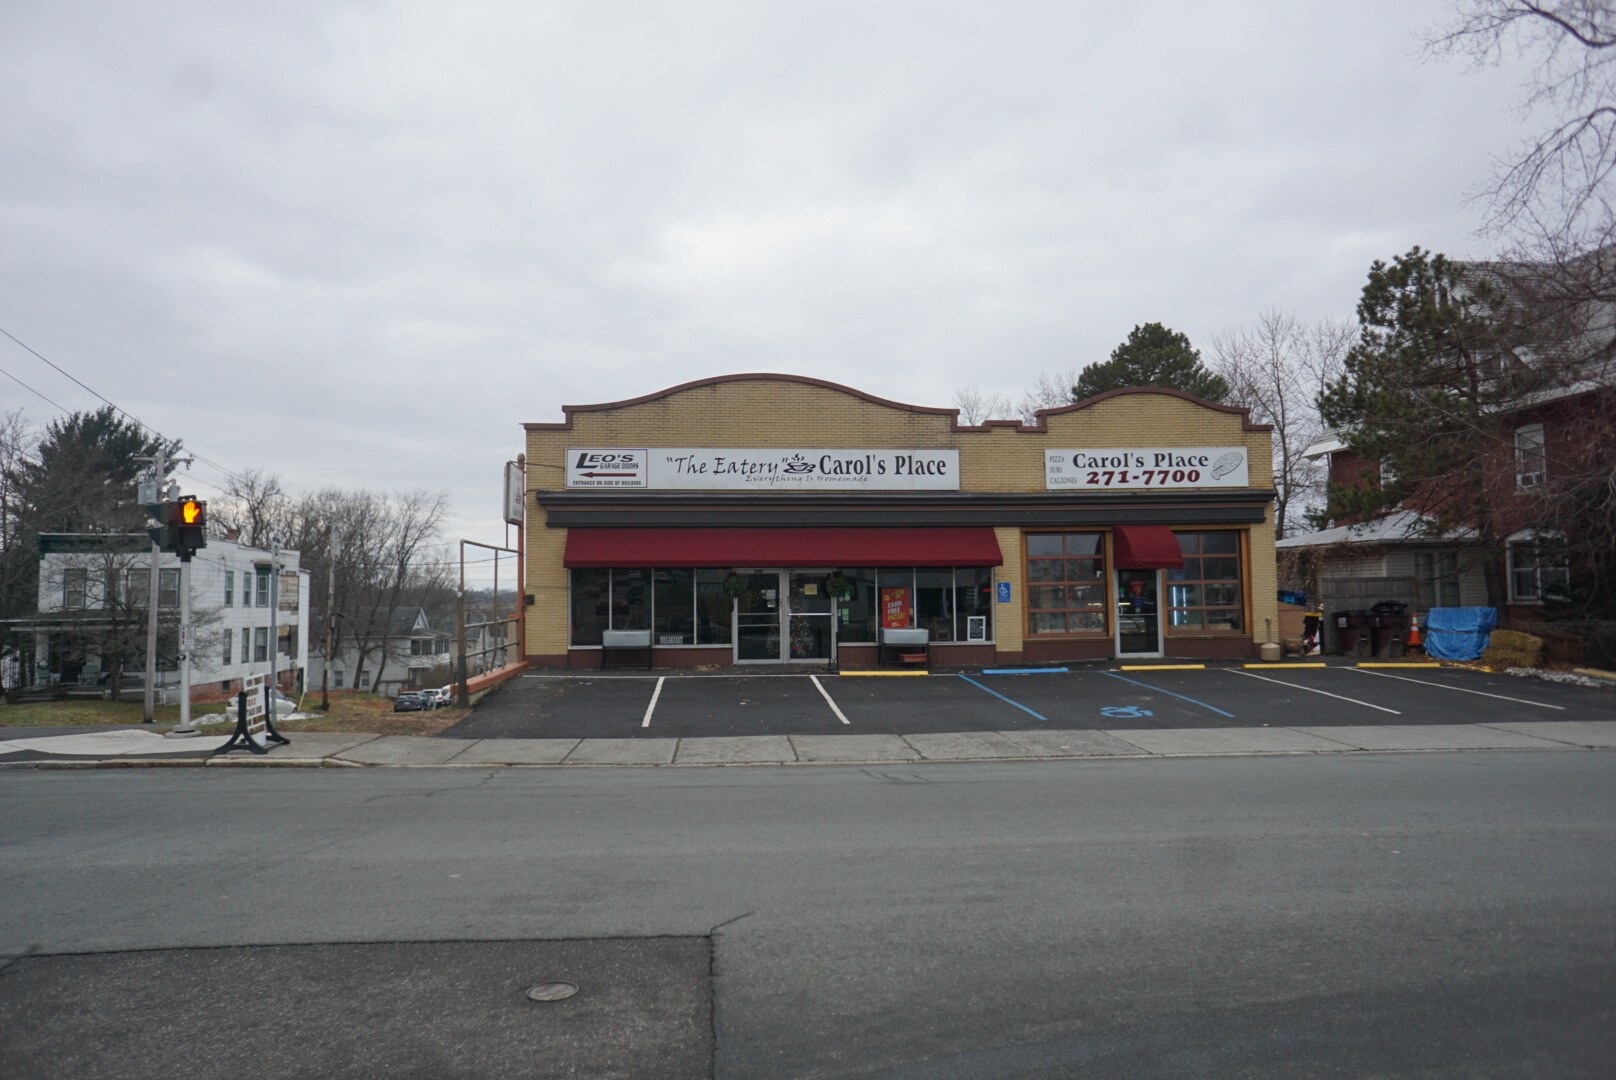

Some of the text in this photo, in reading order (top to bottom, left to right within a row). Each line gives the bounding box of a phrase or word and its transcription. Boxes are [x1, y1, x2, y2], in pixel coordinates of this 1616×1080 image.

[576, 453, 634, 469] LEO'S
[819, 455, 947, 476] Carol's Place
[1072, 452, 1209, 469] Carol's Place
[745, 475, 803, 484] Everything
[816, 475, 868, 483] Homemade
[1086, 469, 1201, 487] 271-7700
